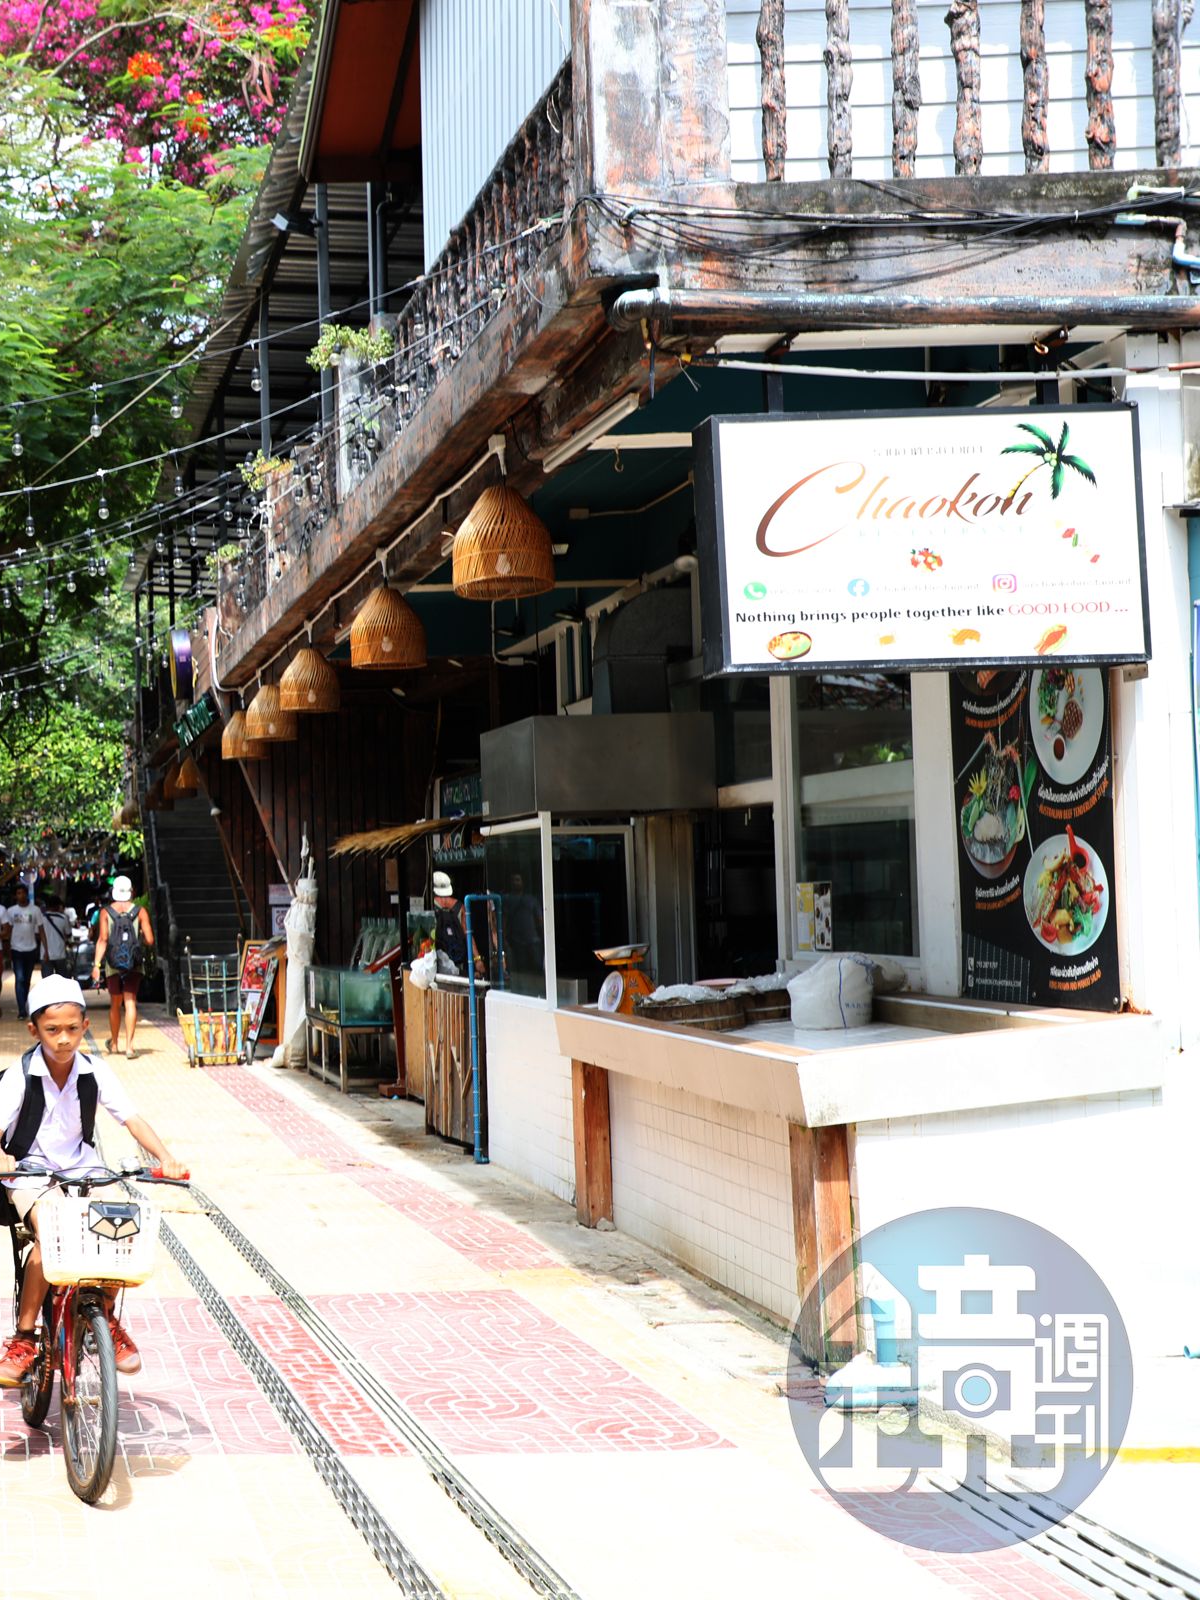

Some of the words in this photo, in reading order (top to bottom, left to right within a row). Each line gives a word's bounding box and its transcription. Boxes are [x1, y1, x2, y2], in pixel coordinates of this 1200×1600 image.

[735, 610, 796, 625] Nothing
[799, 609, 847, 624] brings
[851, 608, 901, 622] people
[906, 606, 972, 621] together
[976, 604, 1005, 617] like
[1008, 603, 1059, 616] GOOD
